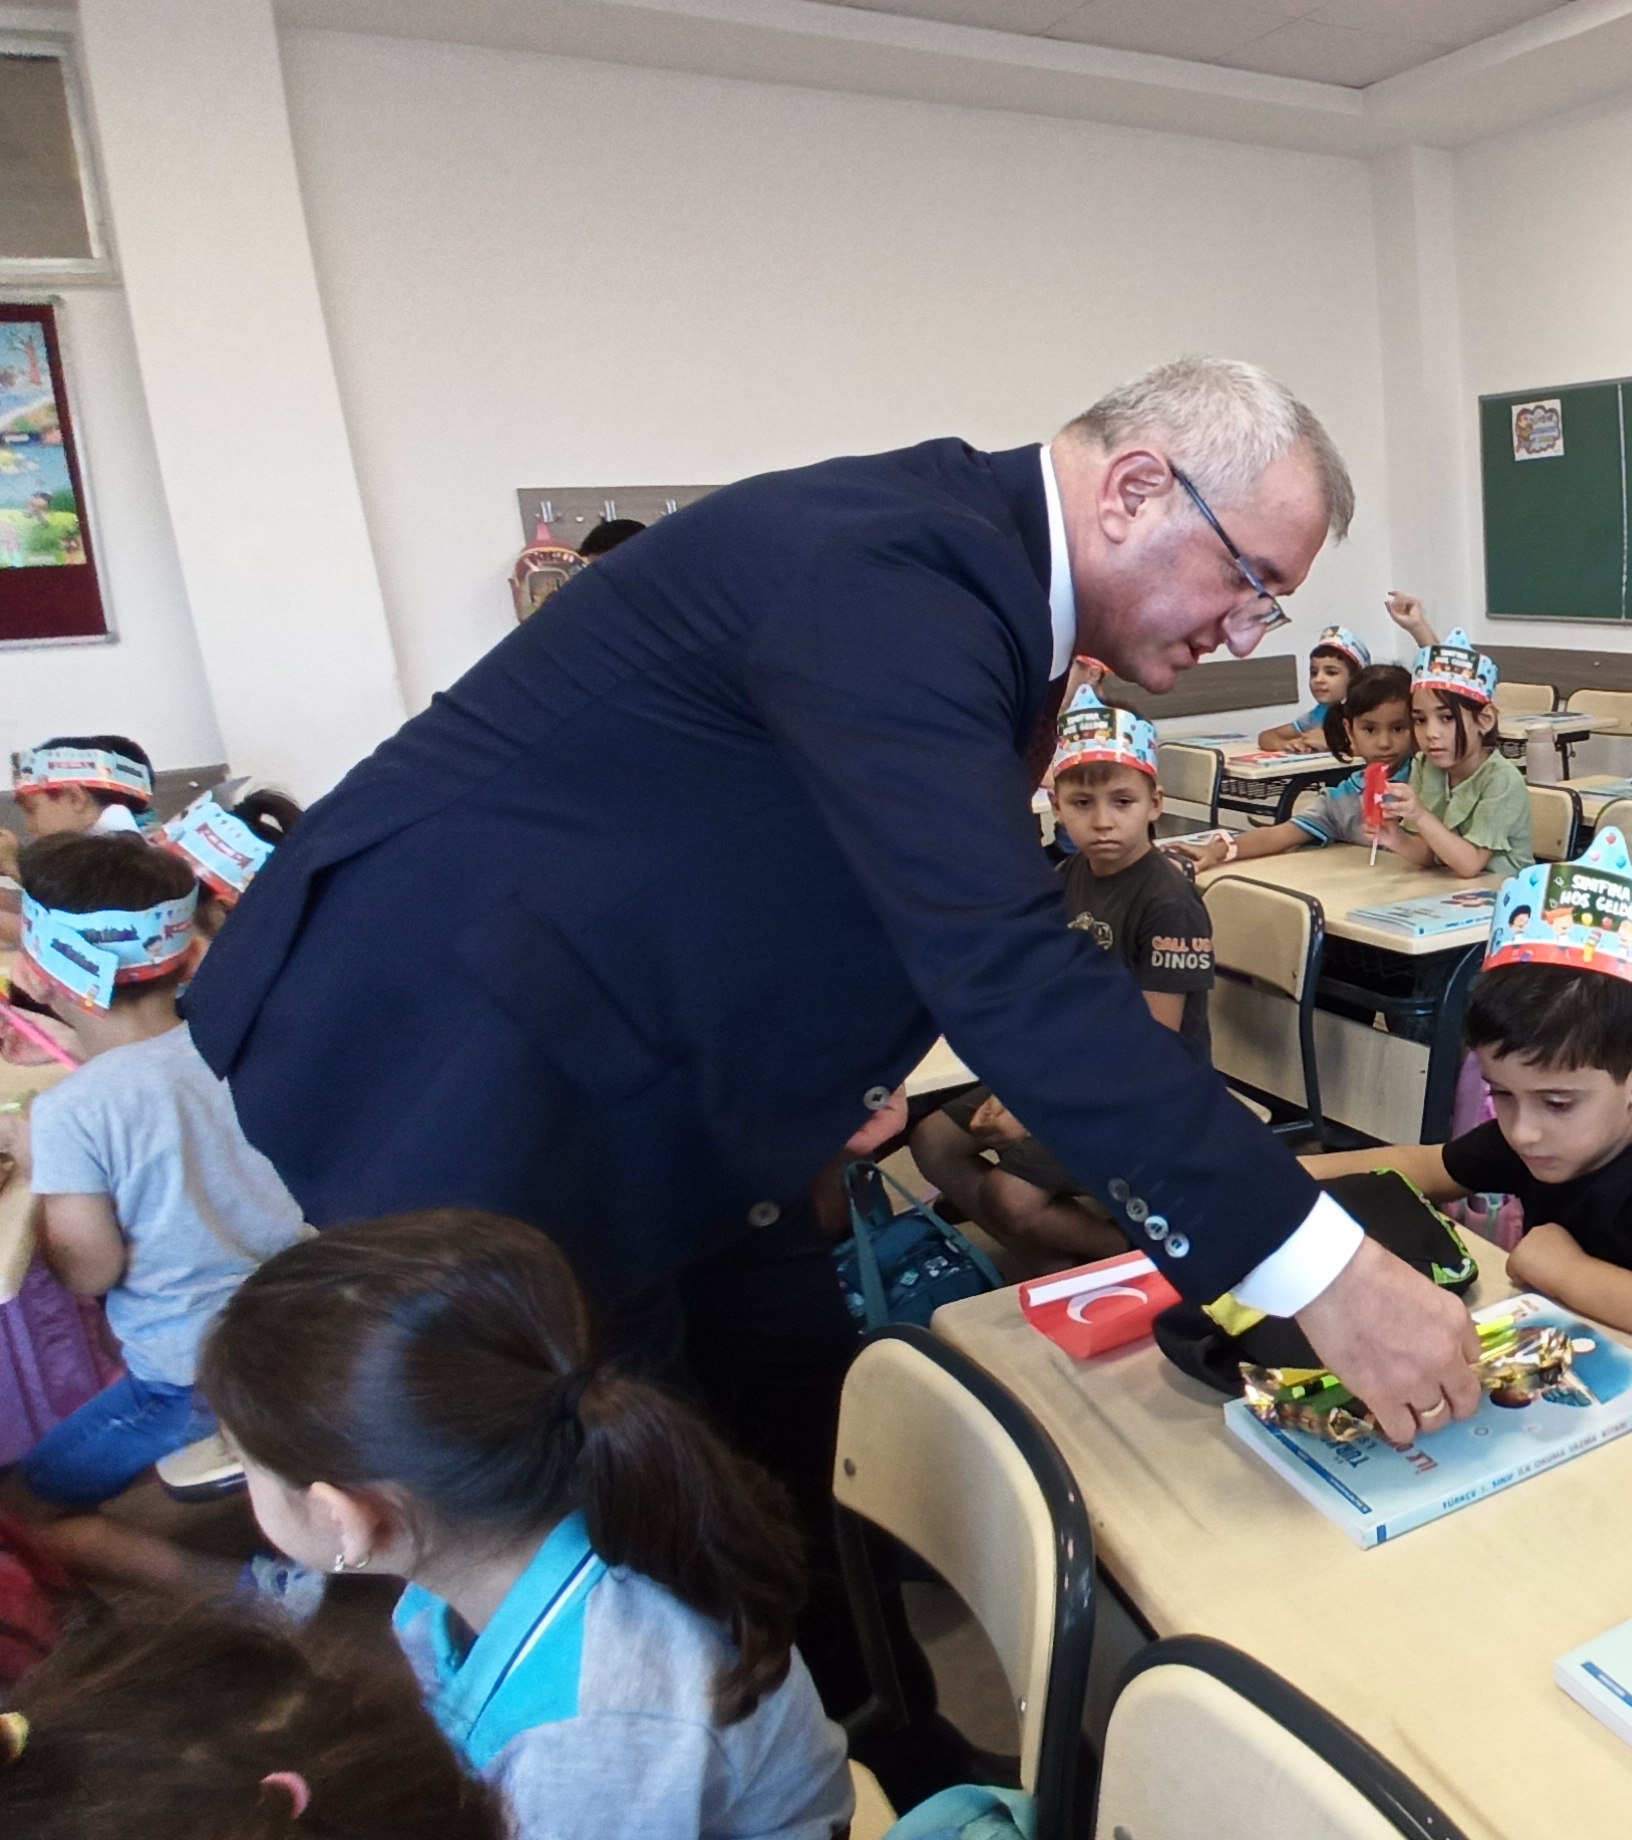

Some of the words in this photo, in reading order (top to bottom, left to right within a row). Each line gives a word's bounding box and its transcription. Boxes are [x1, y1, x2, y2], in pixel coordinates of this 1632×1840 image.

[1571, 874, 1631, 902] SINIFINA
[1152, 936, 1189, 952] CALL
[1152, 951, 1211, 969] DINOS
